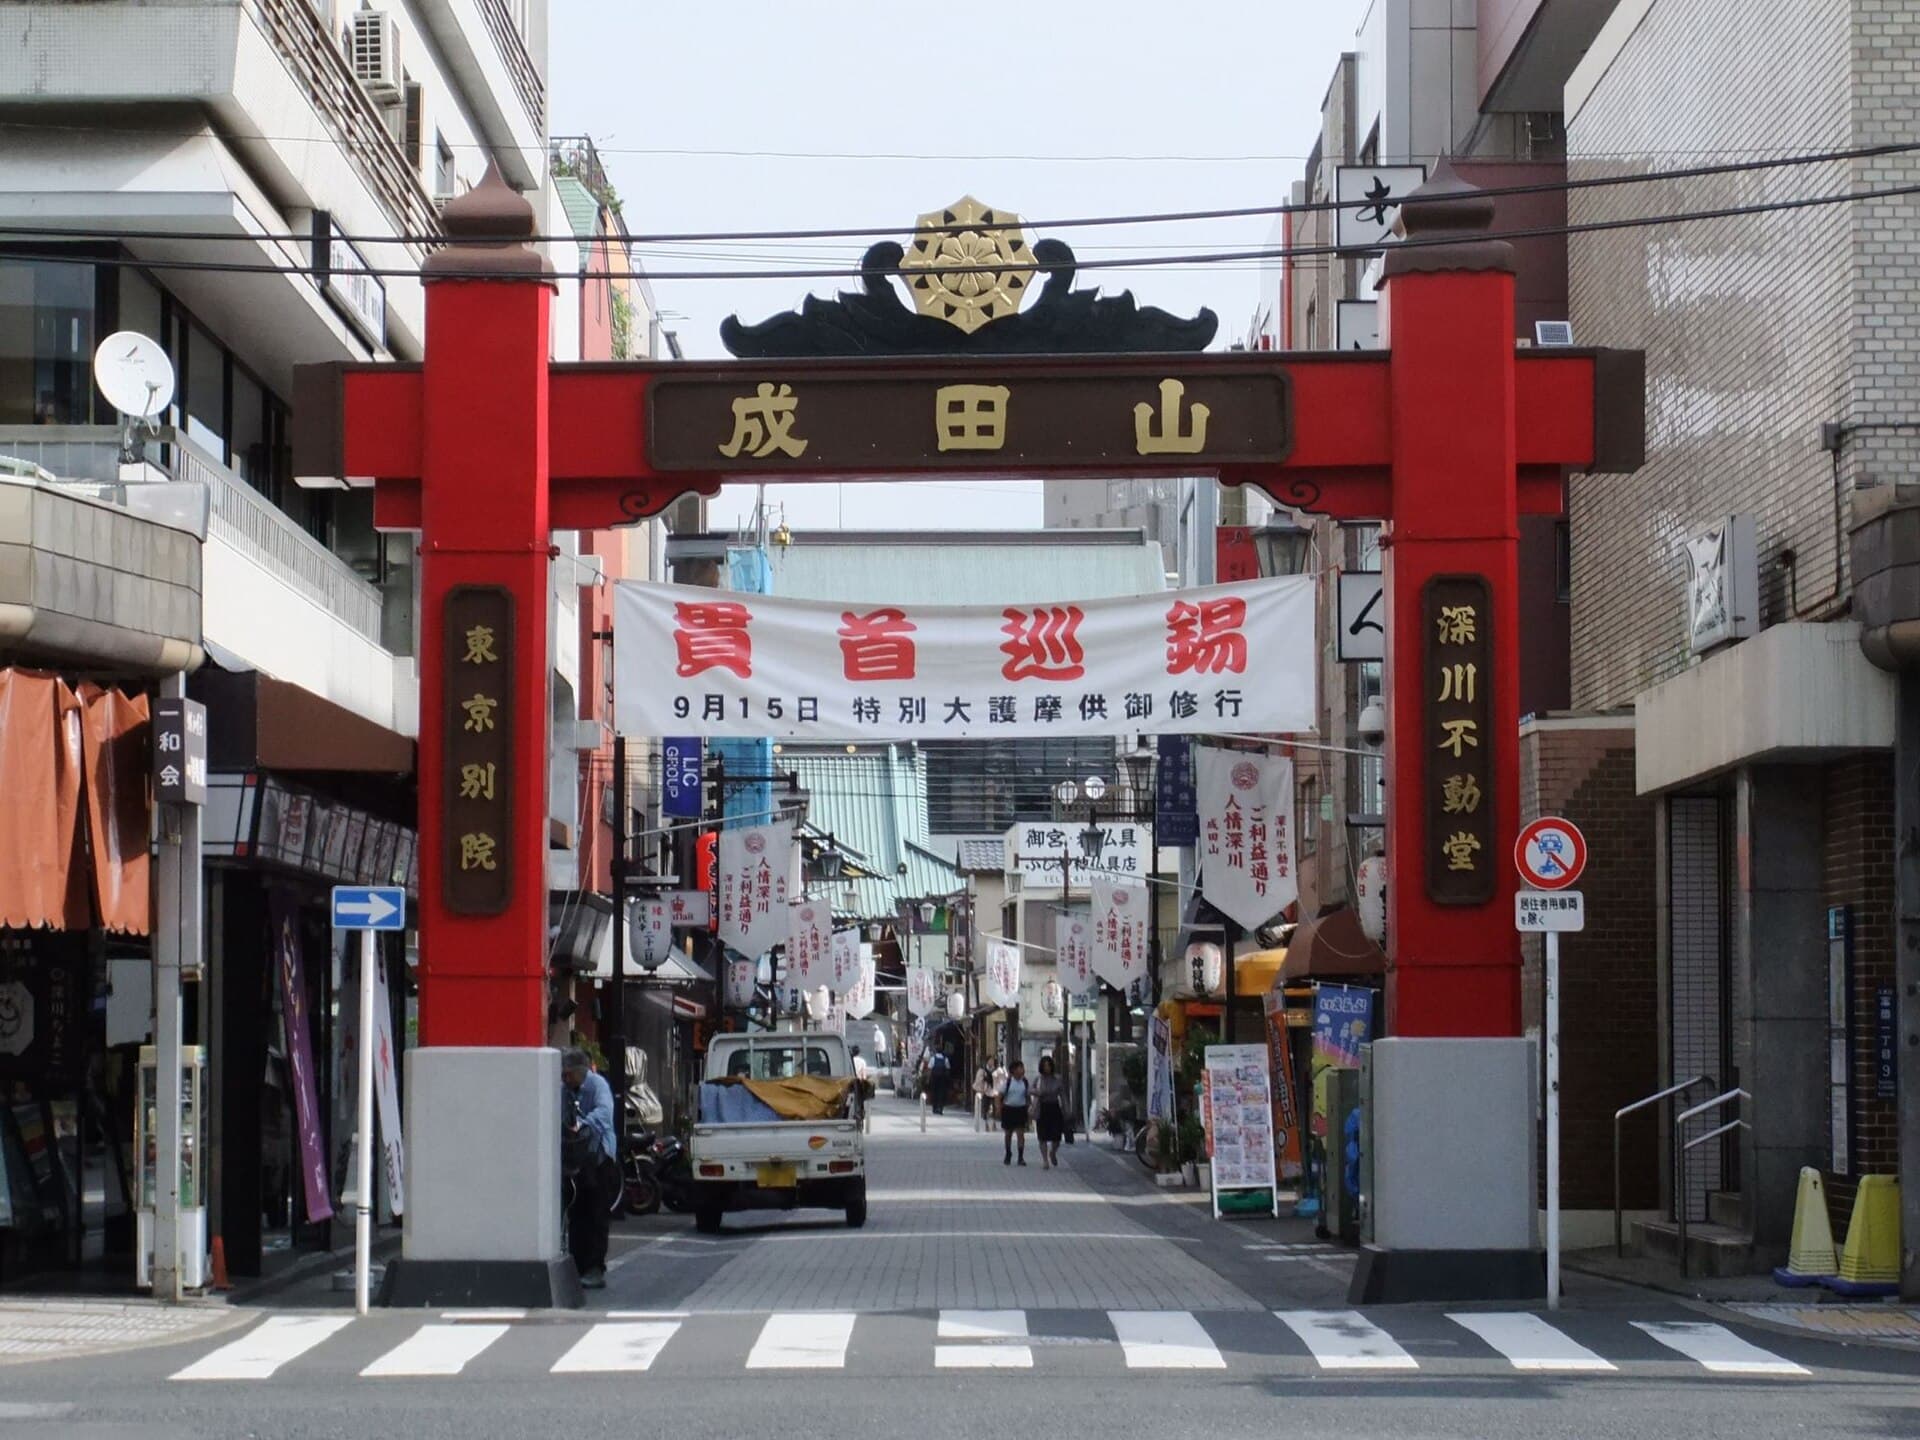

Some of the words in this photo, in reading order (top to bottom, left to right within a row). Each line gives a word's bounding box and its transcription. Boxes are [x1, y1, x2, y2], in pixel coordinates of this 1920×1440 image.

[718, 377, 1211, 460] 成田山
[673, 693, 819, 723] 9月15日
[852, 688, 1244, 725] 特別大護摩供御修行
[1436, 604, 1481, 871] 深川不動堂
[158, 710, 180, 787] 一和会
[459, 624, 498, 871] 東京別院
[666, 746, 679, 798] GROUP
[682, 757, 699, 787] LIC
[1206, 818, 1219, 855] 成田山
[1223, 793, 1245, 869] 人情深川
[1249, 804, 1269, 897] ご利益通り
[756, 856, 771, 914] 人情深川
